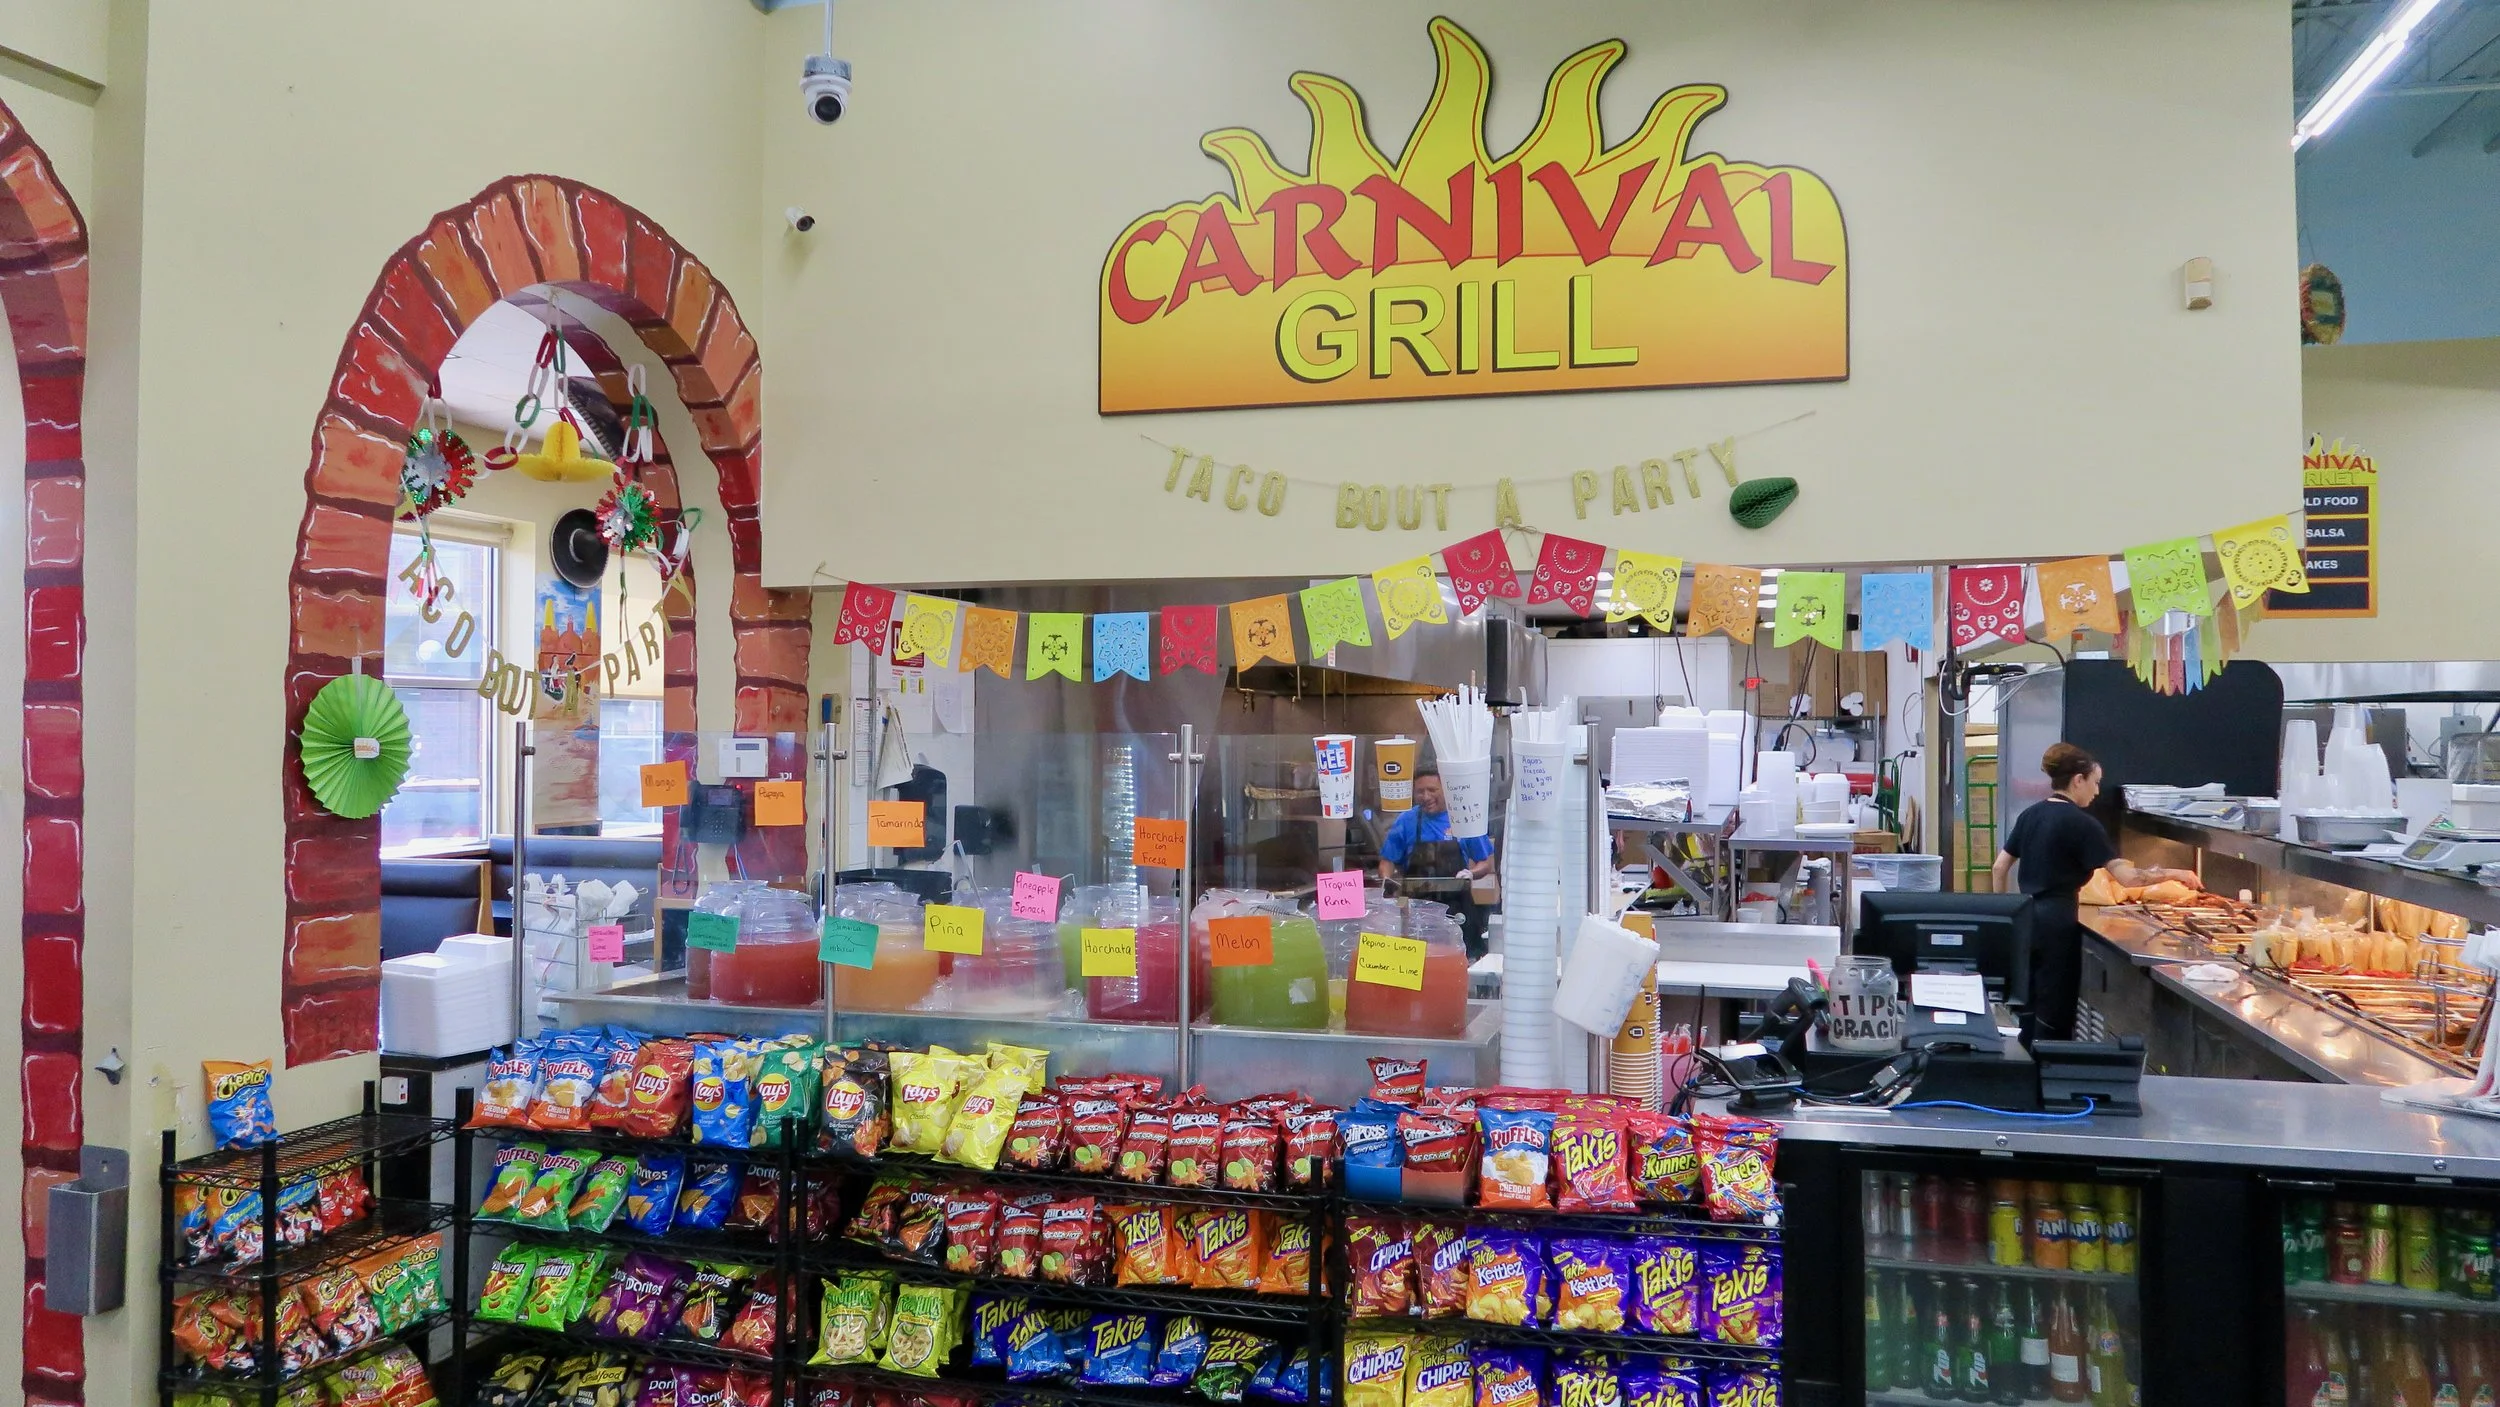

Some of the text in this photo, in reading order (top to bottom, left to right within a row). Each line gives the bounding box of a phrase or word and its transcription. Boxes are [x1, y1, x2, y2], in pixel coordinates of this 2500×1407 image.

[1108, 161, 1837, 324] CARNIVAL
[1276, 274, 1640, 383] GRILL
[1164, 435, 1743, 531] TACO BOUT A PARTY
[2324, 496, 2358, 506] FOOD
[2306, 528, 2345, 538] SALSA
[871, 815, 926, 830] Tamarindo
[1139, 829, 1185, 845] Horchata
[1016, 874, 1054, 895] Pineapple
[1320, 877, 1357, 891] Tropical
[929, 915, 964, 938] Piña
[1084, 938, 1132, 956] Horchata
[1216, 932, 1261, 950] Melon
[545, 1060, 594, 1081] RUFFLES
[217, 1069, 269, 1101] Cheetos
[1490, 1126, 1545, 1150] RUFFLES
[495, 1148, 539, 1167] RUFFLES
[540, 1154, 581, 1172] RUFFLES
[1557, 1132, 1617, 1181] Takis
[1645, 1152, 1698, 1180] Runners
[1499, 1184, 1531, 1195] CHEDDAR
[1198, 1213, 1246, 1258] Takis
[1433, 1228, 1455, 1248] Takis
[1476, 1262, 1524, 1286] Kettlez
[1562, 1262, 1587, 1281] Takis
[1636, 1251, 1694, 1305] Takis
[626, 1278, 663, 1296] Doritos
[1569, 1273, 1618, 1297] Kettlez
[1710, 1264, 1767, 1311] Takis
[1093, 1315, 1147, 1358] Takis
[1349, 1346, 1405, 1383] CHIPPZ
[1421, 1354, 1446, 1369] Takis
[1416, 1361, 1471, 1391] CHIPPZ
[1557, 1372, 1618, 1407] Takis
